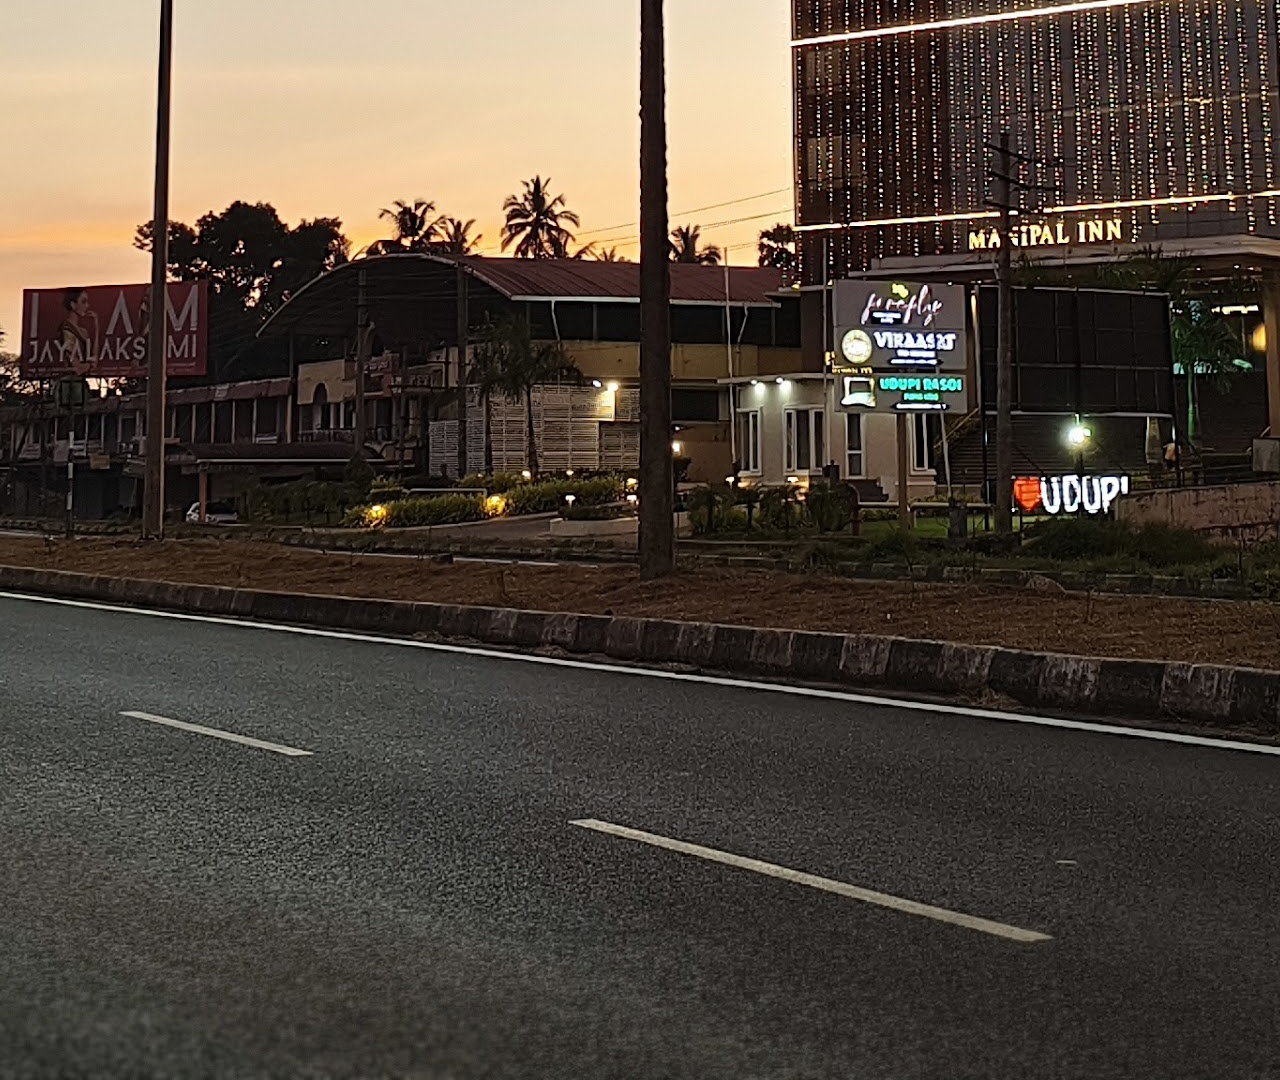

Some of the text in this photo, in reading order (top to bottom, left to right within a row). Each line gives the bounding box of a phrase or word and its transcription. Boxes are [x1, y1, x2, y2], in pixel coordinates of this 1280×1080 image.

[1078, 218, 1122, 244] INN
[30, 292, 39, 338] I
[28, 334, 197, 363] JAYALAKSMI
[879, 377, 921, 391] UDUPI
